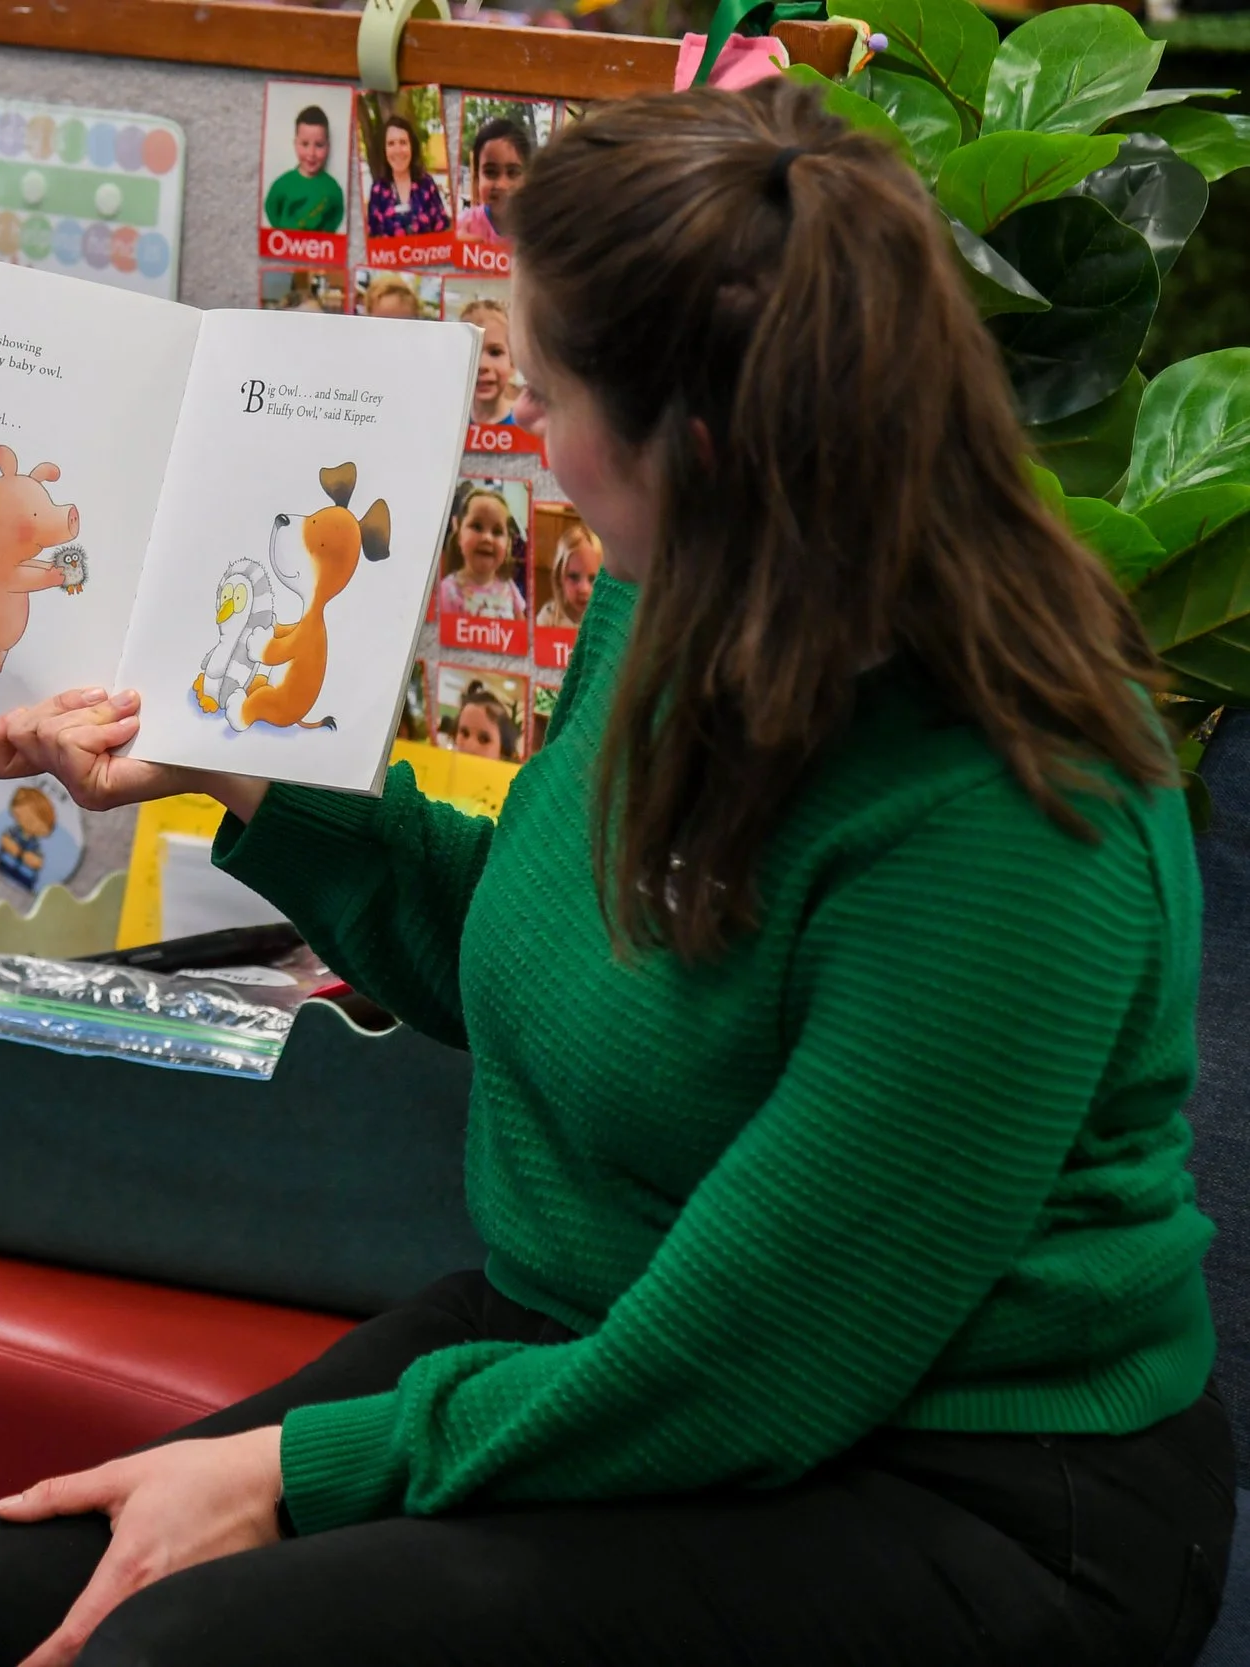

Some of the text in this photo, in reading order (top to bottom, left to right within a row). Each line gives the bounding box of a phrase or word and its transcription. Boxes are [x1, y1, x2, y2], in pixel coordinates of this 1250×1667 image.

[267, 231, 334, 259] Owen
[371, 245, 452, 265] Mrs Cayzer
[9, 355, 36, 375] baby
[39, 366, 63, 379] owl.
[314, 387, 332, 400] and
[333, 388, 359, 402] Small
[360, 391, 384, 407] Grey
[266, 402, 294, 420] Fluffy
[323, 408, 342, 420] said
[343, 409, 377, 426] Kipper.
[470, 424, 513, 450] Zoe
[456, 618, 514, 652] Emily
